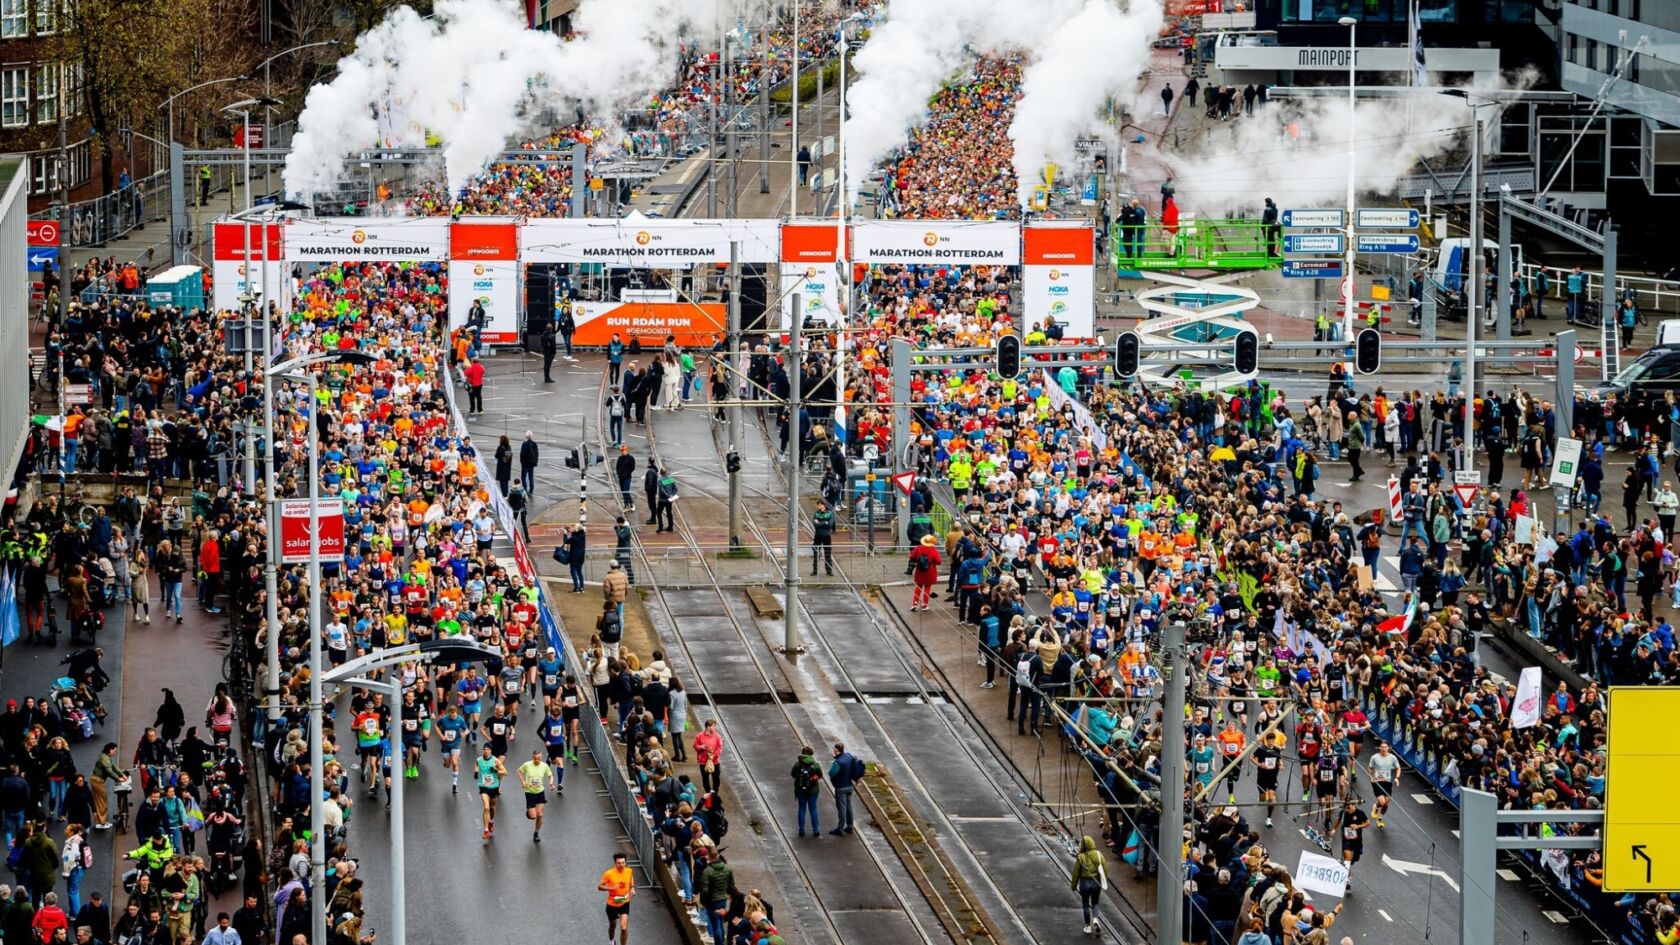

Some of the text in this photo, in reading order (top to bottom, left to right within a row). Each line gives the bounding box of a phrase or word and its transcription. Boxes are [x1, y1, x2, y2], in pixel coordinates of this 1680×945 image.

[1299, 49, 1359, 66] MAINPORT
[300, 246, 430, 255] MARATHON ROTTERDAM
[583, 248, 715, 257] MARATHON ROTTERDAM
[869, 248, 1004, 258] MARATHON ROTTERDAM
[607, 318, 629, 326] RUN
[633, 318, 665, 326] RDAM
